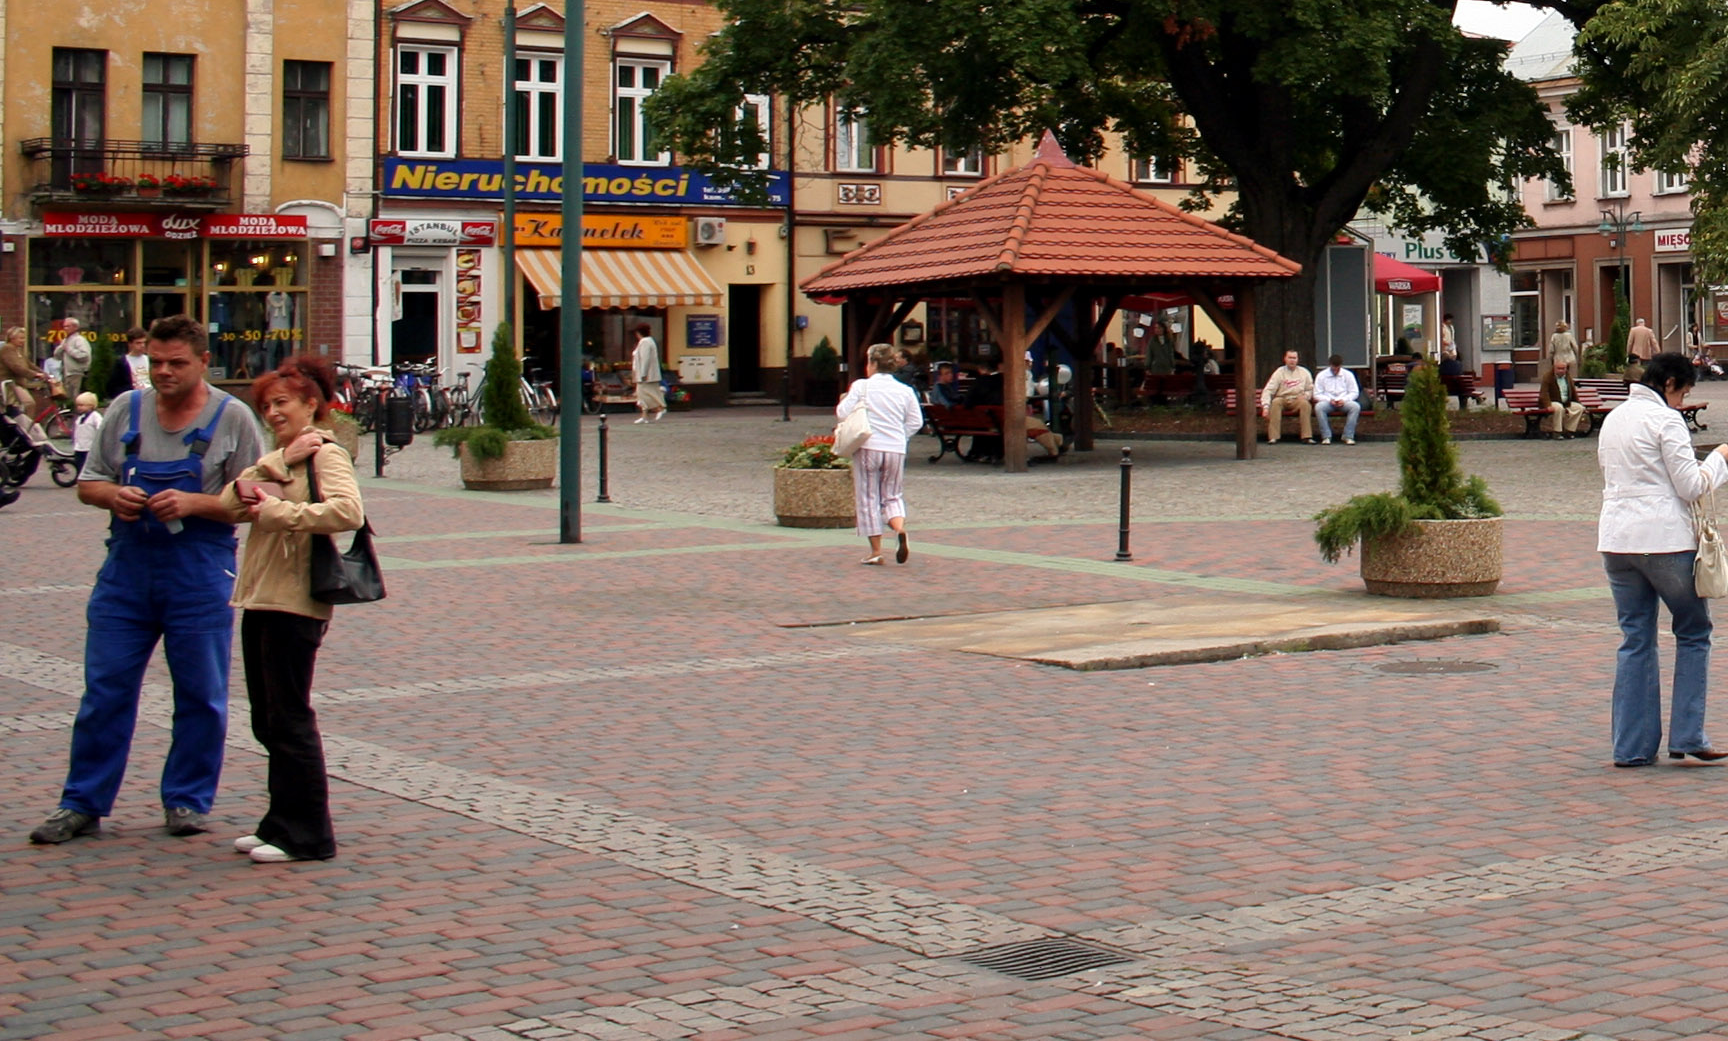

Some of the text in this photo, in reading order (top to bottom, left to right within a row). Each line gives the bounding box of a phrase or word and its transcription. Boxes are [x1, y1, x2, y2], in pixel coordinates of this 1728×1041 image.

[391, 164, 690, 196] Nieruchomości
[78, 214, 118, 224] MODA
[239, 216, 276, 226] MODA
[45, 223, 150, 234] MŁODZIEŻOWA
[209, 224, 307, 235] MŁODZIEŻOWA
[409, 222, 459, 236] ISTANBUL
[527, 219, 644, 239] Kamelek
[164, 230, 198, 240] ODZIEŻ
[1657, 233, 1692, 249] MIĘSO
[1405, 242, 1444, 260] Plus
